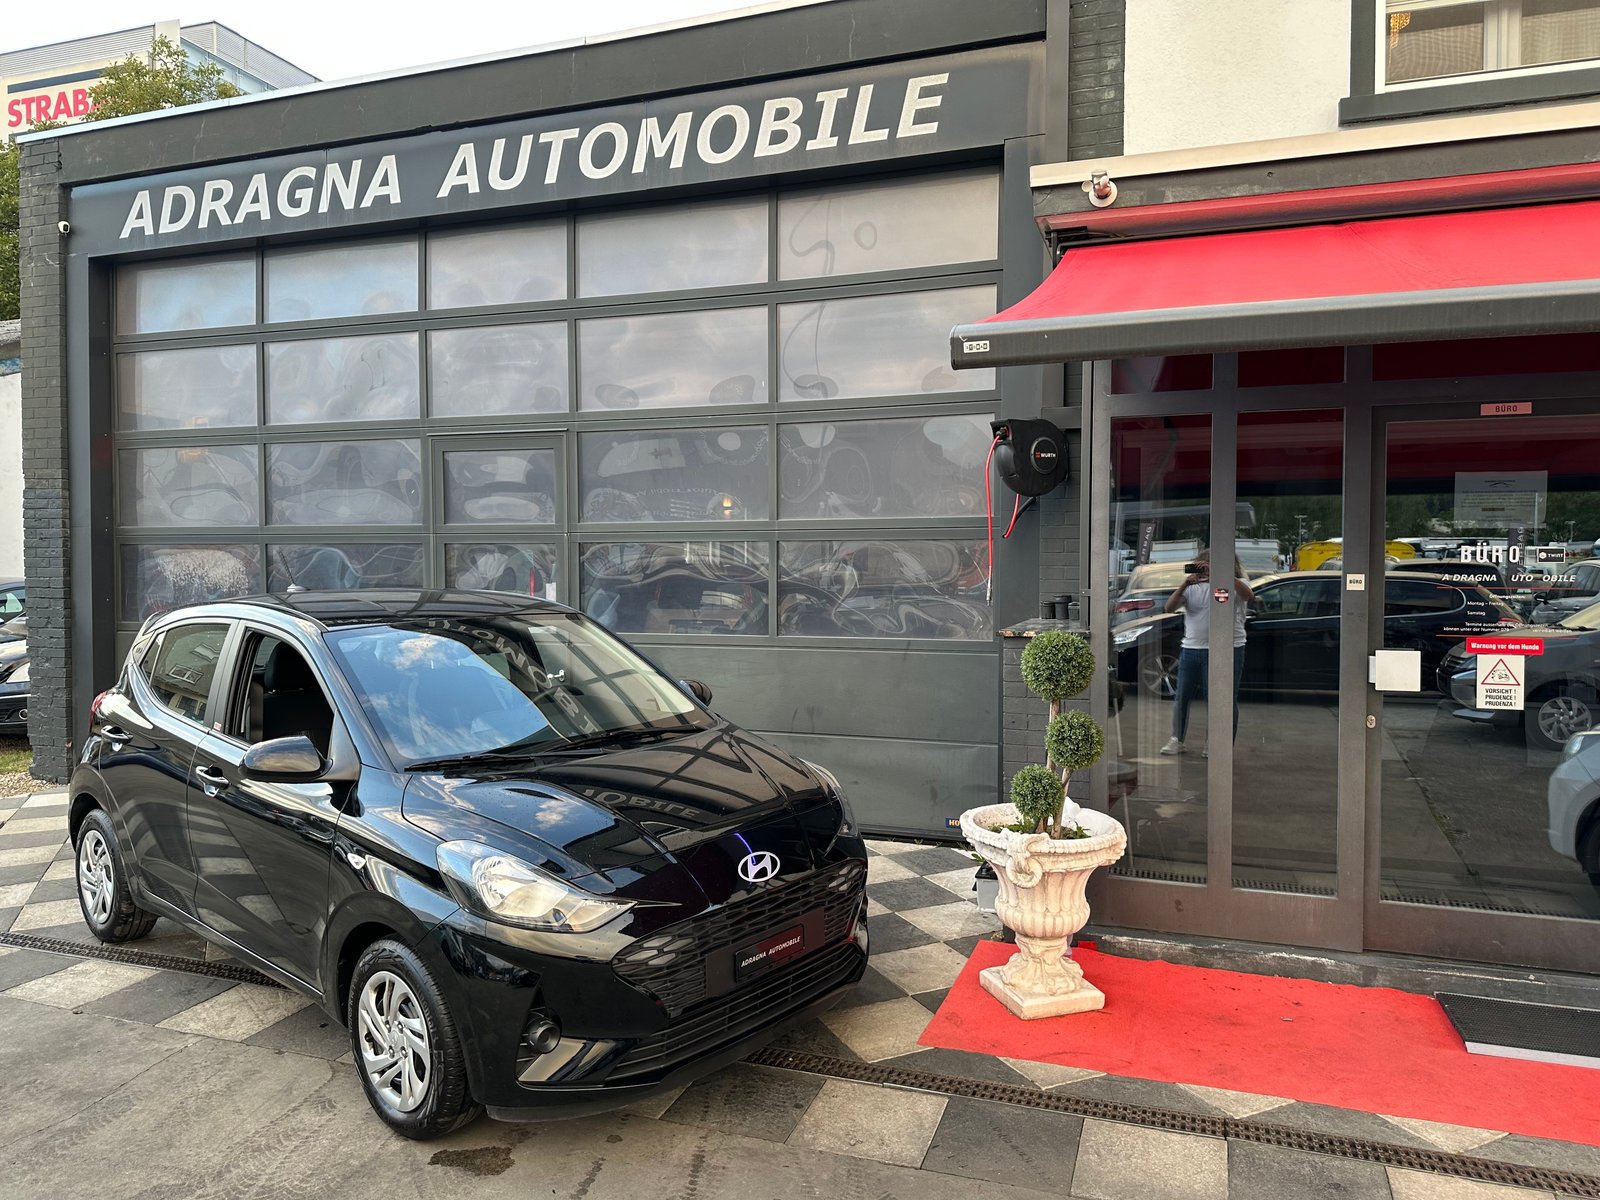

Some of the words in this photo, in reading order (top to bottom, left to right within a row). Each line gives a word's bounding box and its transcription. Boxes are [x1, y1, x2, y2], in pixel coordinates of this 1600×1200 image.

[7, 88, 103, 128] STRAB
[120, 154, 402, 240] ADRAGNA
[436, 72, 950, 200] AUTOMOBILE
[1495, 405, 1518, 413] BÜRO
[1461, 542, 1520, 563] BÜRO
[1470, 642, 1497, 651] Warnung
[1521, 643, 1540, 651] Hunde
[740, 951, 767, 968] ADRAGNA
[768, 936, 801, 955] AUTOMOBILE
